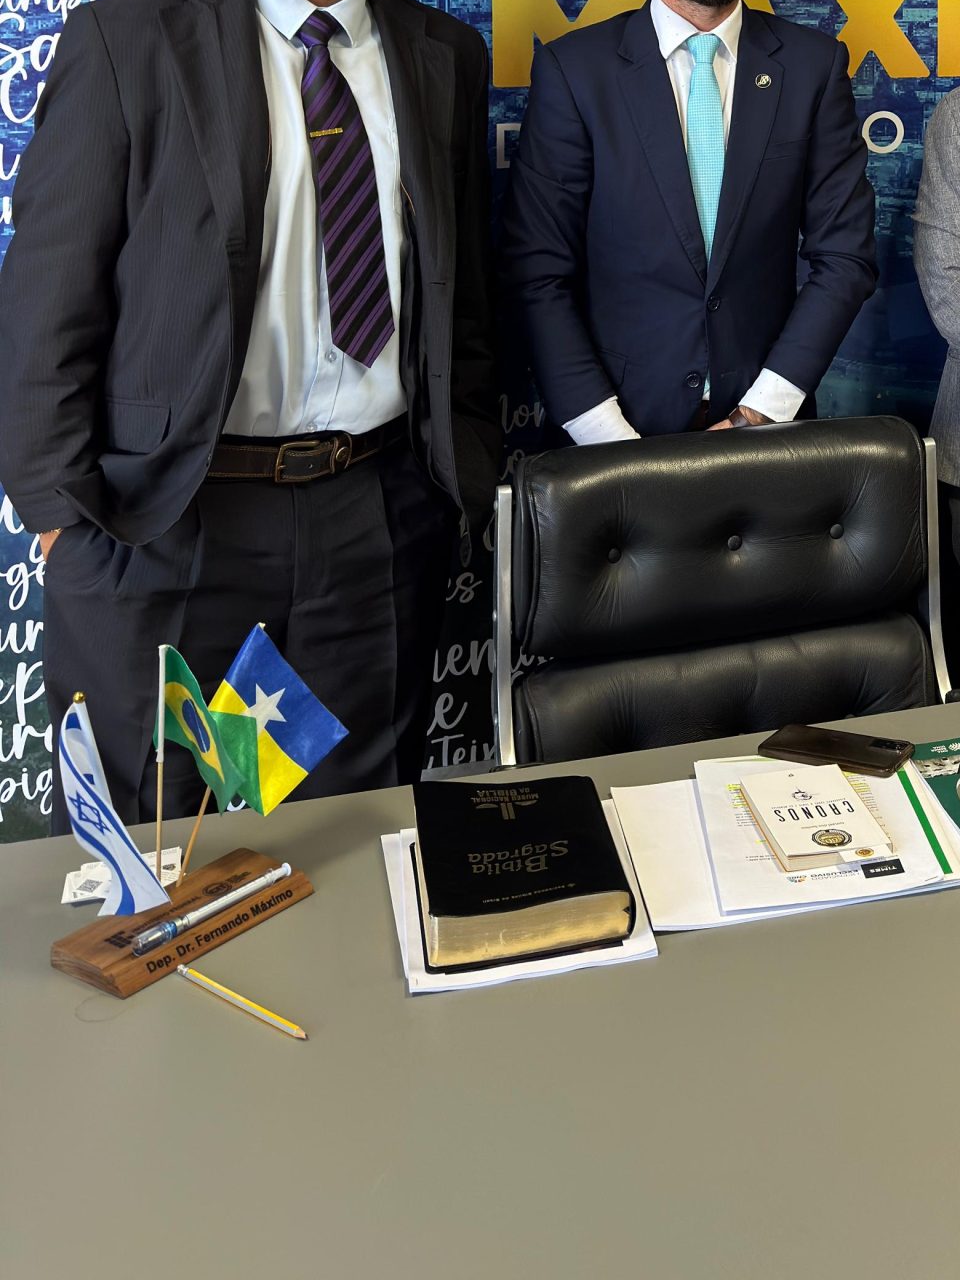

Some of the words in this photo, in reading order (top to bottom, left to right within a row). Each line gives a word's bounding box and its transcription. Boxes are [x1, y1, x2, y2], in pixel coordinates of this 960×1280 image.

[773, 800, 855, 822] CRONOS
[467, 840, 569, 865] Sagrada
[146, 955, 176, 973] Dep.
[176, 942, 195, 958] Dr.
[195, 911, 250, 947] Fernando
[250, 889, 293, 917] Máximo
